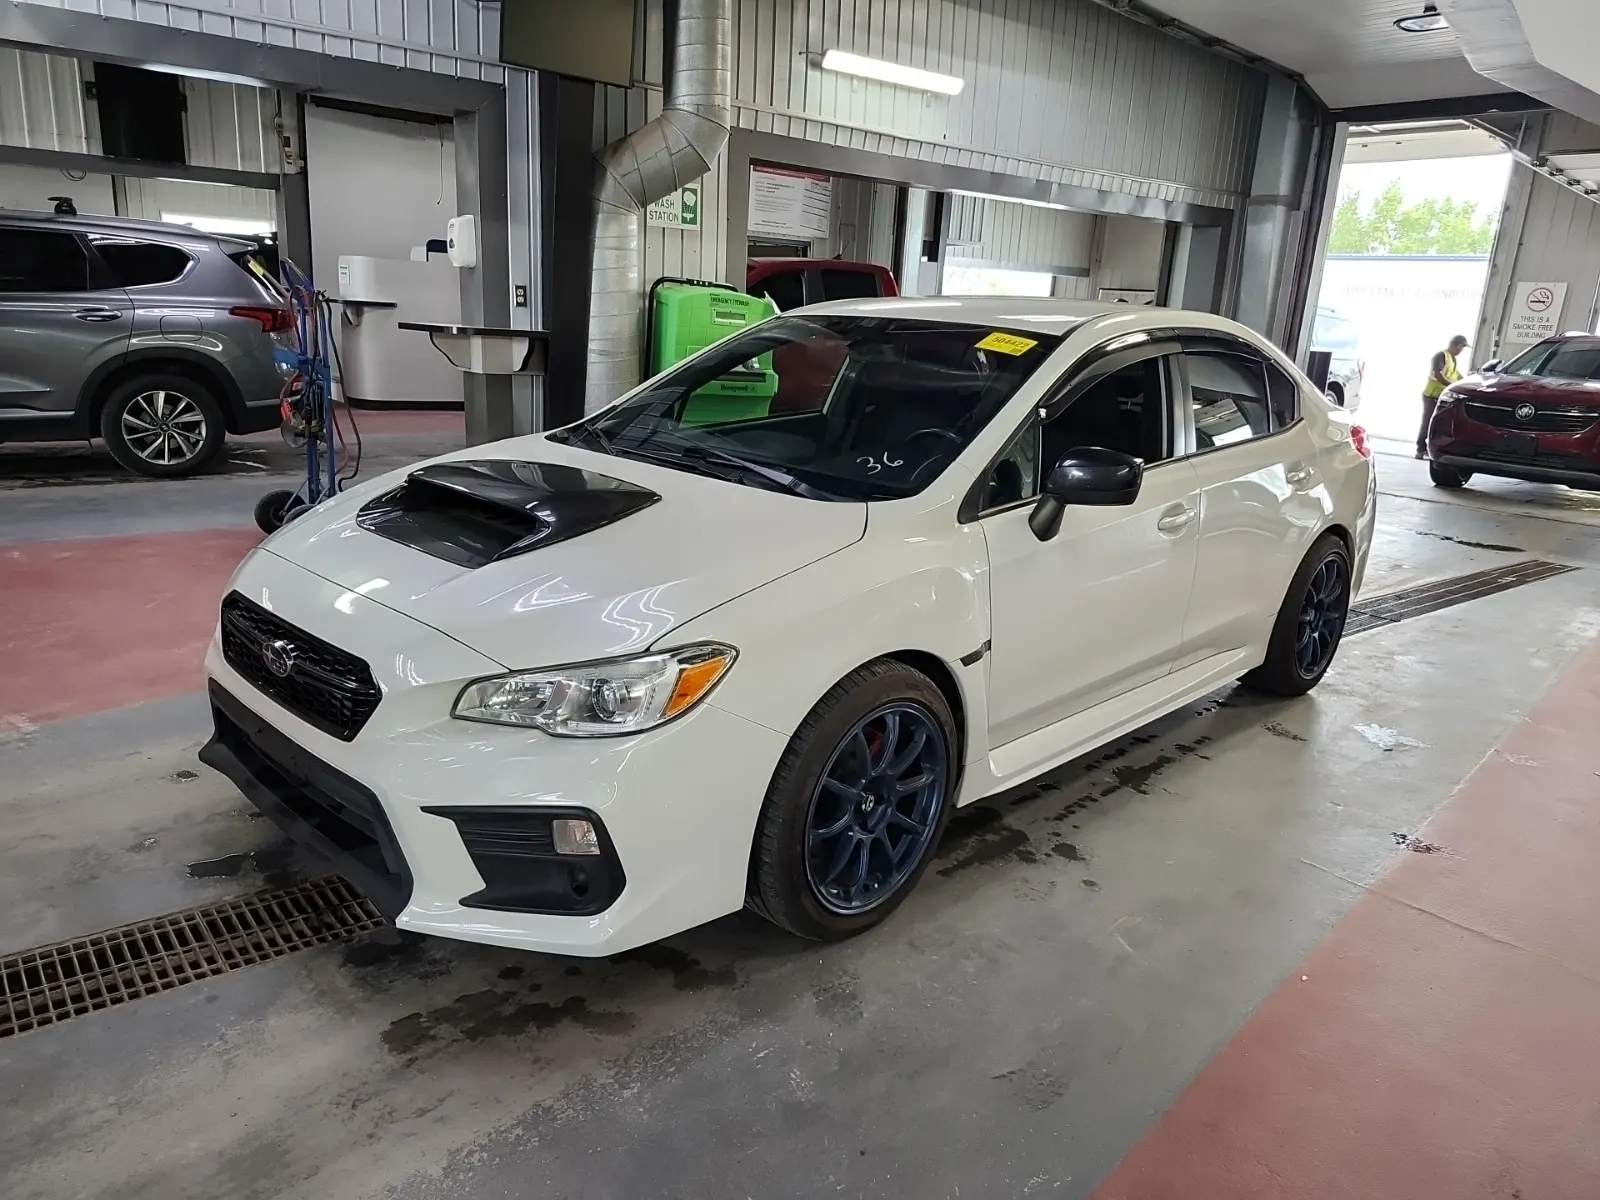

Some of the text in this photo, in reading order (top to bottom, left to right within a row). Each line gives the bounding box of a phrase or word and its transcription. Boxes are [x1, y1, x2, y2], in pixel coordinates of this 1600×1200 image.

[648, 210, 679, 223] STATION
[710, 296, 750, 307] EMERGENCY EYEWASH
[1520, 315, 1535, 323] THIS
[1512, 323, 1554, 332] SMOKE FREE
[1516, 331, 1546, 339] BUILDING
[856, 451, 904, 475] 36
